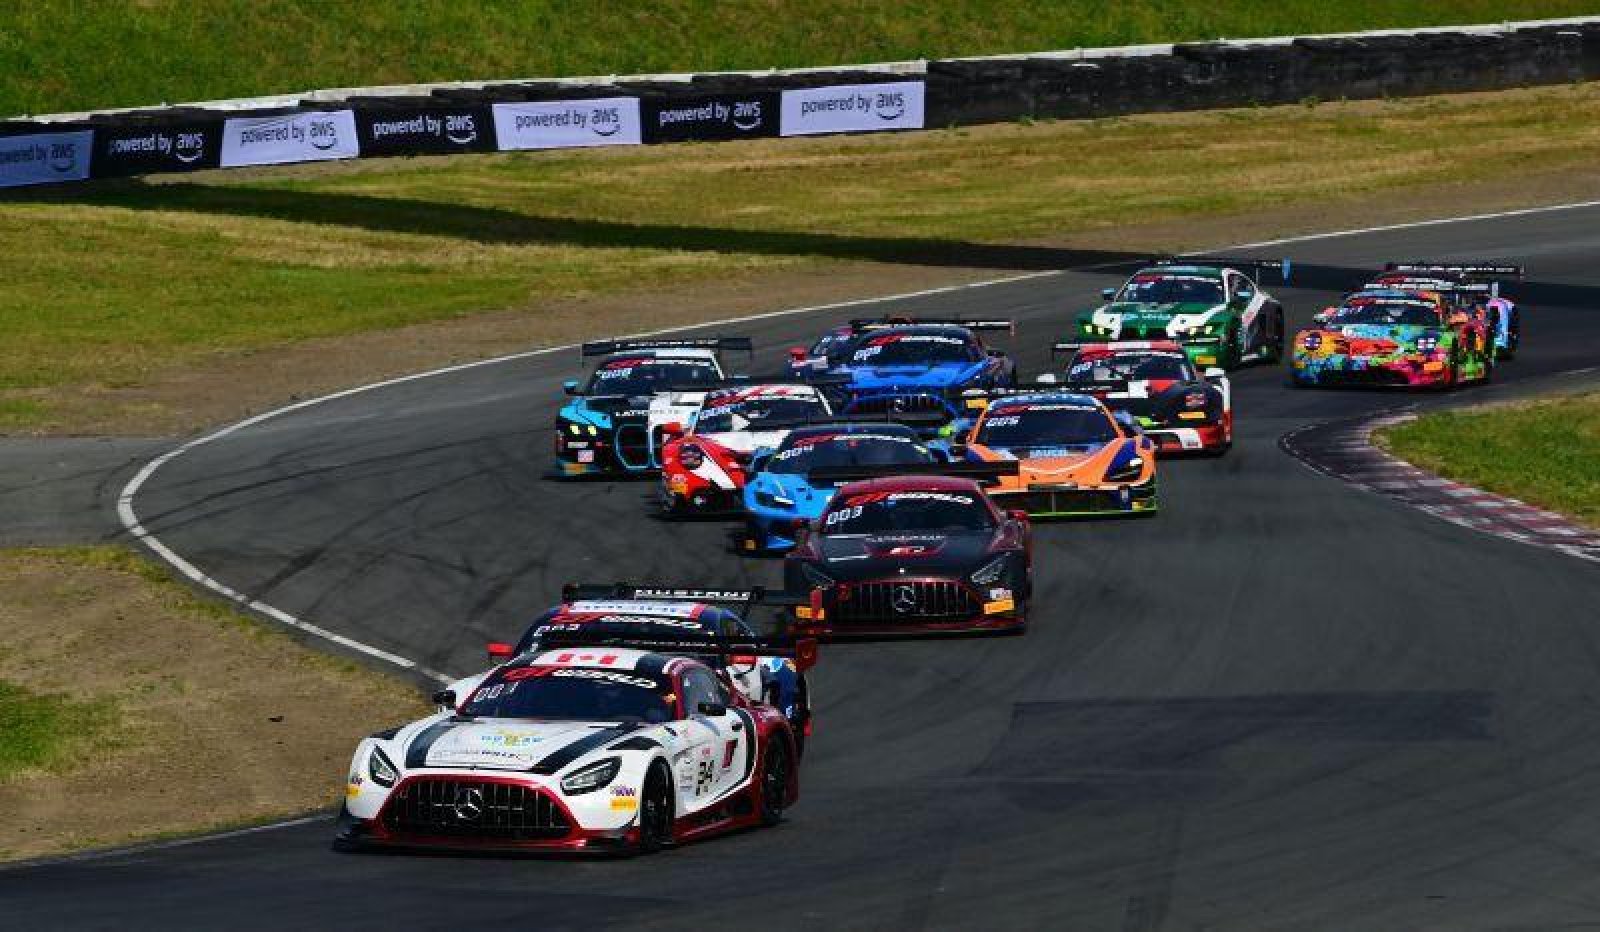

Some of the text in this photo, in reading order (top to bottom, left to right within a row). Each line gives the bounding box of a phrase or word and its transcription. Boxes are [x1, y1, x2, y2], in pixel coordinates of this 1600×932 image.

[660, 101, 761, 128] powered by aws
[801, 92, 904, 118] powered by aws
[373, 115, 475, 140] powered by aws
[516, 107, 619, 132] powered by aws
[157, 132, 172, 155] by
[176, 132, 203, 150] aws
[240, 121, 336, 147] powered by aws
[51, 142, 77, 160] aws
[825, 505, 864, 525] 003
